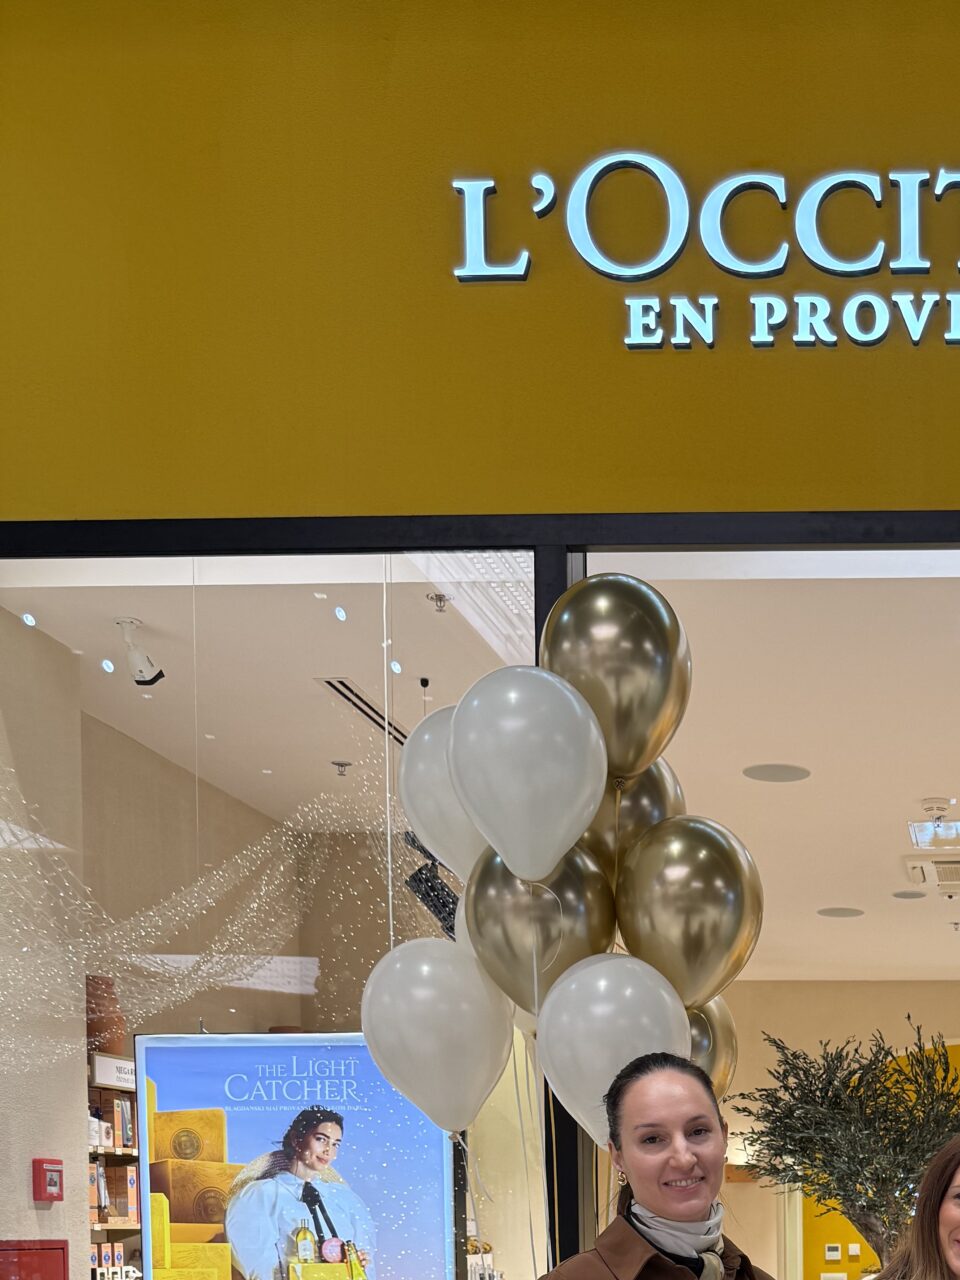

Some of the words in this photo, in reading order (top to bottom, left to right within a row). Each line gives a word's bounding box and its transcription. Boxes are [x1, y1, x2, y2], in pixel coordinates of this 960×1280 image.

[624, 294, 719, 349] EN
[256, 1064, 288, 1077] THE
[292, 1055, 360, 1077] LIGHT
[224, 1073, 362, 1102] CATCHER
